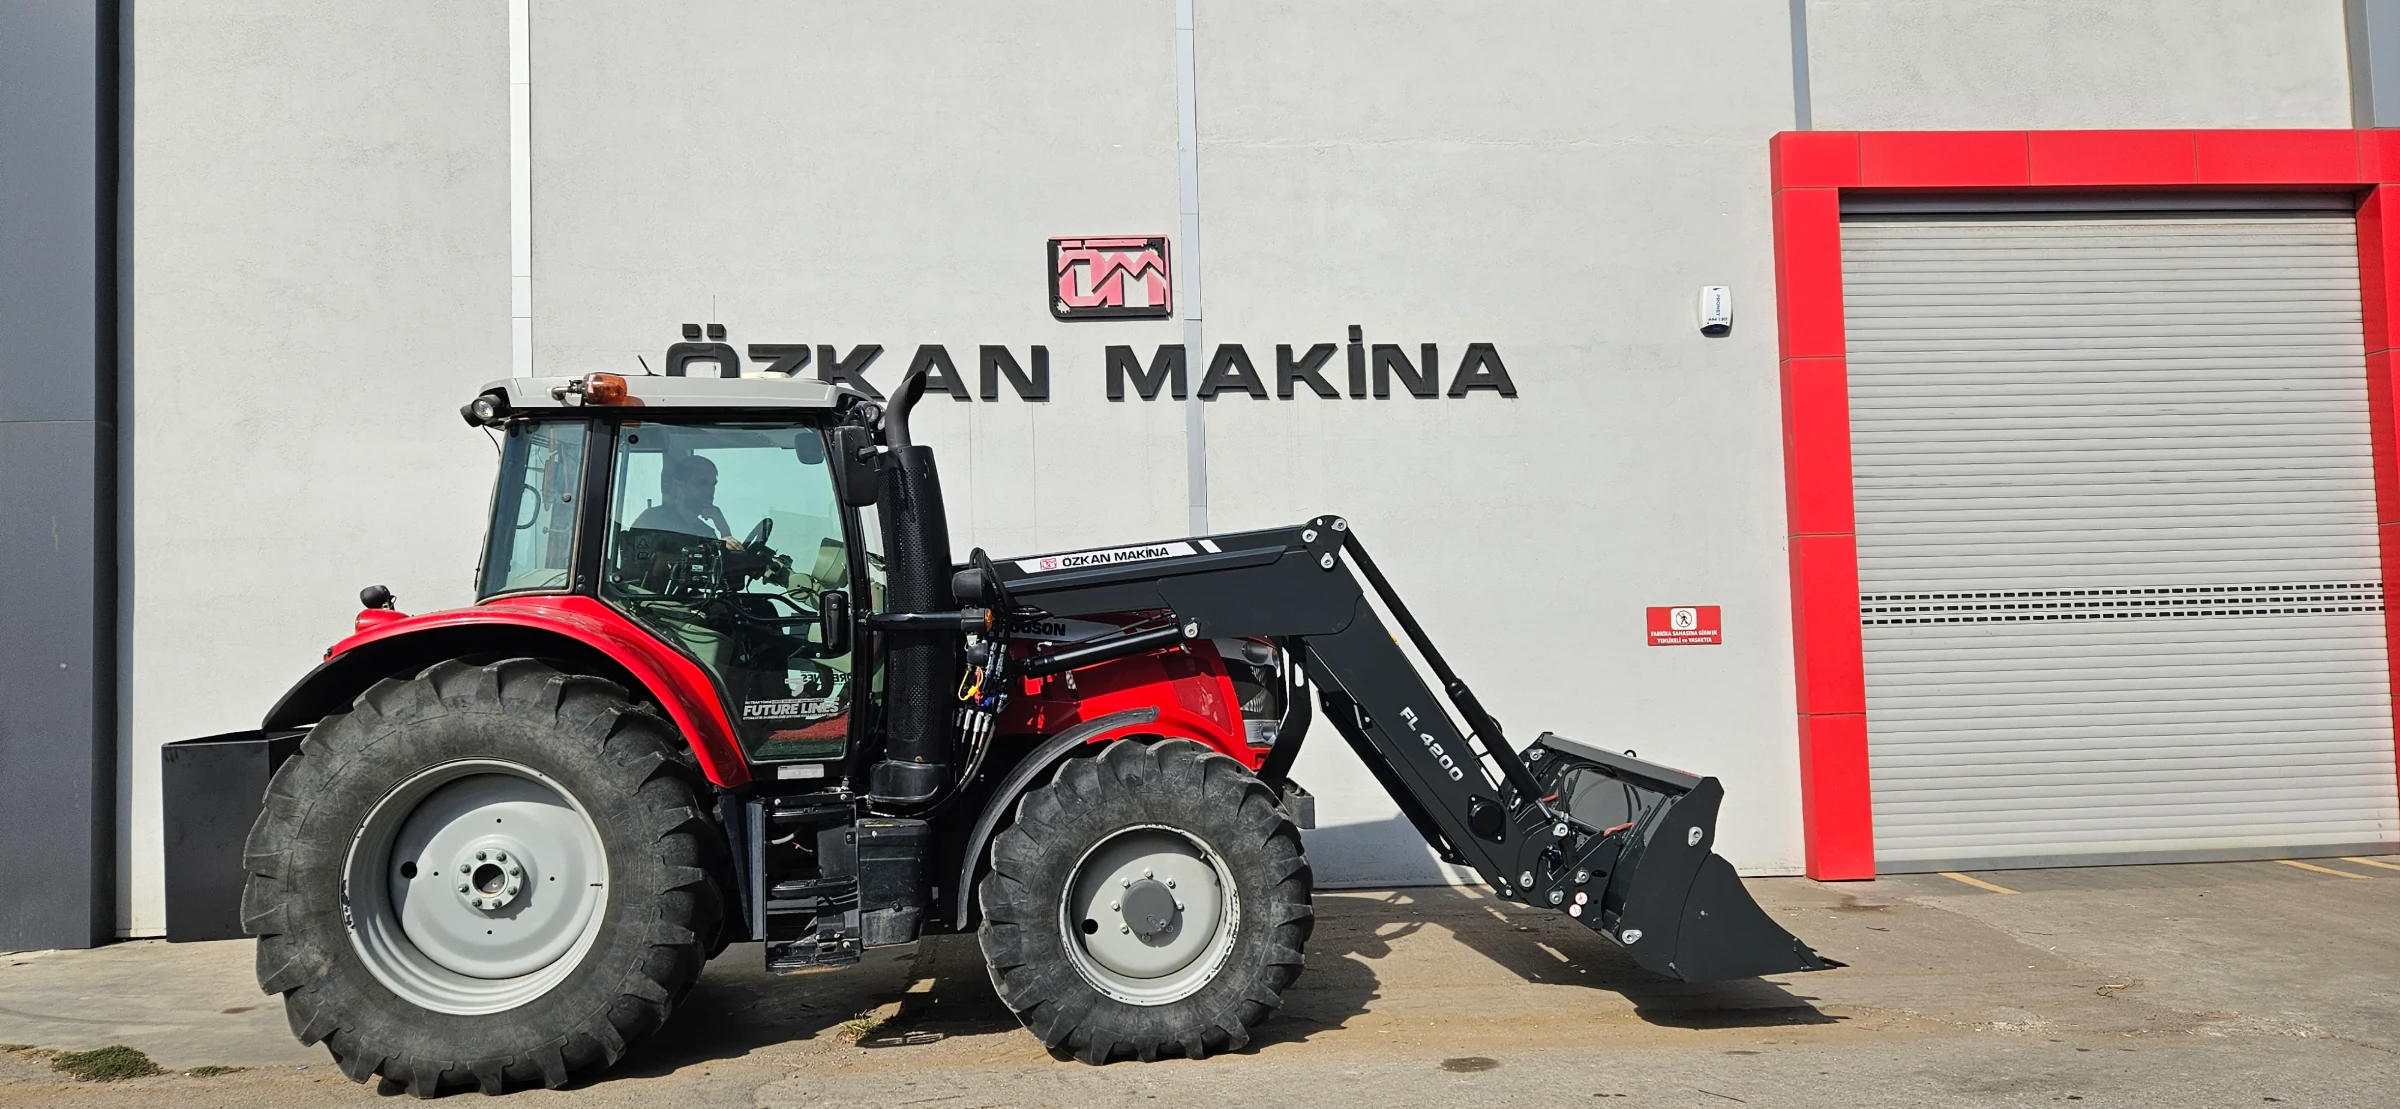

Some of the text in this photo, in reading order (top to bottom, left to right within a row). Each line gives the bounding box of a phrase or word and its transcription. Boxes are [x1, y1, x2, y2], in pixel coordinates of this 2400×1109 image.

[665, 323, 1520, 403] ÖZKAN MAKİNA
[1061, 552, 1111, 567] ÖZKAN
[1114, 546, 1170, 562] MAKİNA
[743, 703, 799, 717] FUTURE
[800, 701, 840, 715] LINES
[1399, 706, 1464, 782] FL 4200
